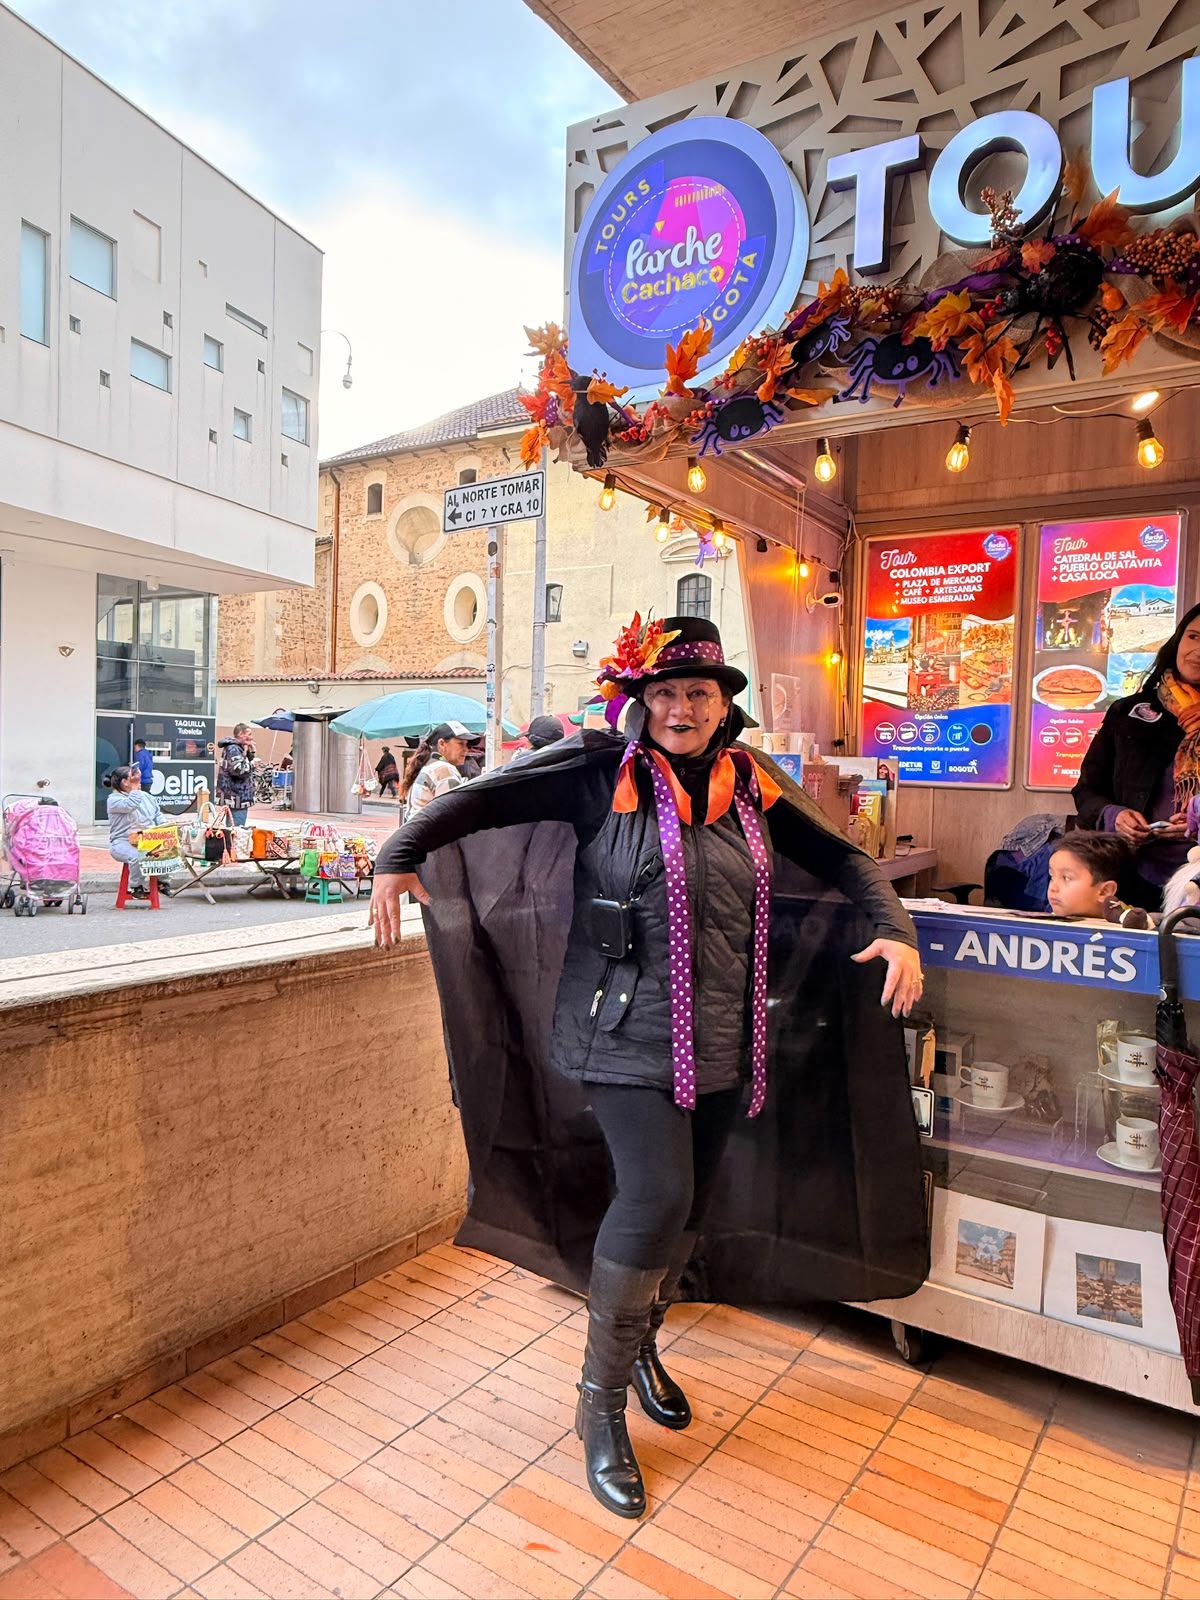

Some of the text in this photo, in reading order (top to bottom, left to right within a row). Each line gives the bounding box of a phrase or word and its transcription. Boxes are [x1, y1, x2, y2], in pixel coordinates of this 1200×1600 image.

[596, 179, 650, 255] TOURS
[626, 225, 724, 280] Parche
[621, 265, 725, 305] Cachaco
[447, 478, 540, 508] AL NORTE TOMAR
[481, 508, 487, 519] 7
[490, 505, 498, 518] Y
[500, 501, 523, 517] CRA
[526, 498, 539, 512] 10
[1053, 537, 1088, 554] Tour
[880, 549, 917, 570] Tour
[1053, 550, 1138, 564] CATEDRAL DE SAL
[1059, 562, 1099, 572] PUEBLO
[1100, 558, 1162, 570] GUATAVITA
[889, 562, 992, 579] COLOMBIA EXPORT
[1059, 572, 1088, 582] CASA
[1089, 570, 1119, 581] LOCA
[902, 580, 928, 588] PLAZA
[930, 578, 941, 586] DE
[943, 575, 983, 585] MERCADO
[901, 596, 928, 605] MUSEO
[928, 593, 976, 604] ESMERALDA
[902, 587, 922, 597] CAFÉ
[174, 719, 206, 728] TAQUILLA
[149, 769, 209, 796] Delia
[954, 929, 1137, 982] ANDRÉS
